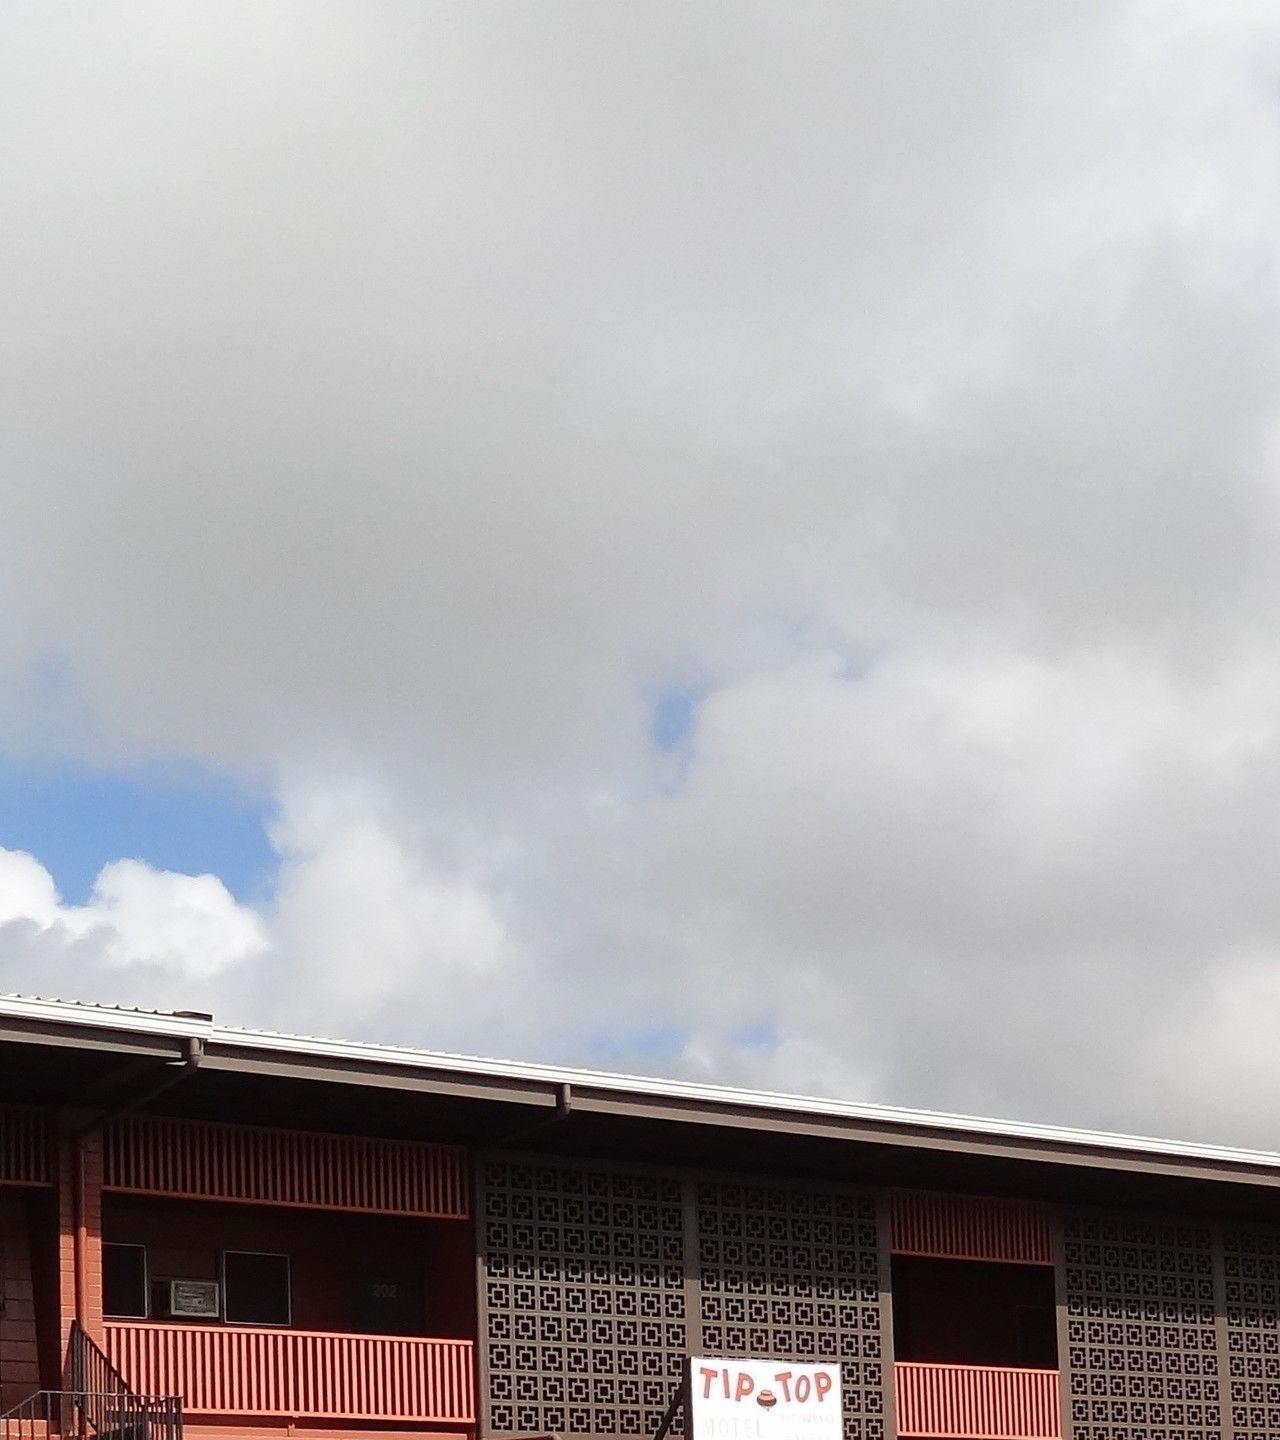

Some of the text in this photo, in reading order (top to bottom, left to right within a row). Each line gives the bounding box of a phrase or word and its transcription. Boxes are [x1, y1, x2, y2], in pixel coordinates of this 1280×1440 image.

[700, 1367, 833, 1403] TIP TOP
[703, 1417, 765, 1439] MOTEL
